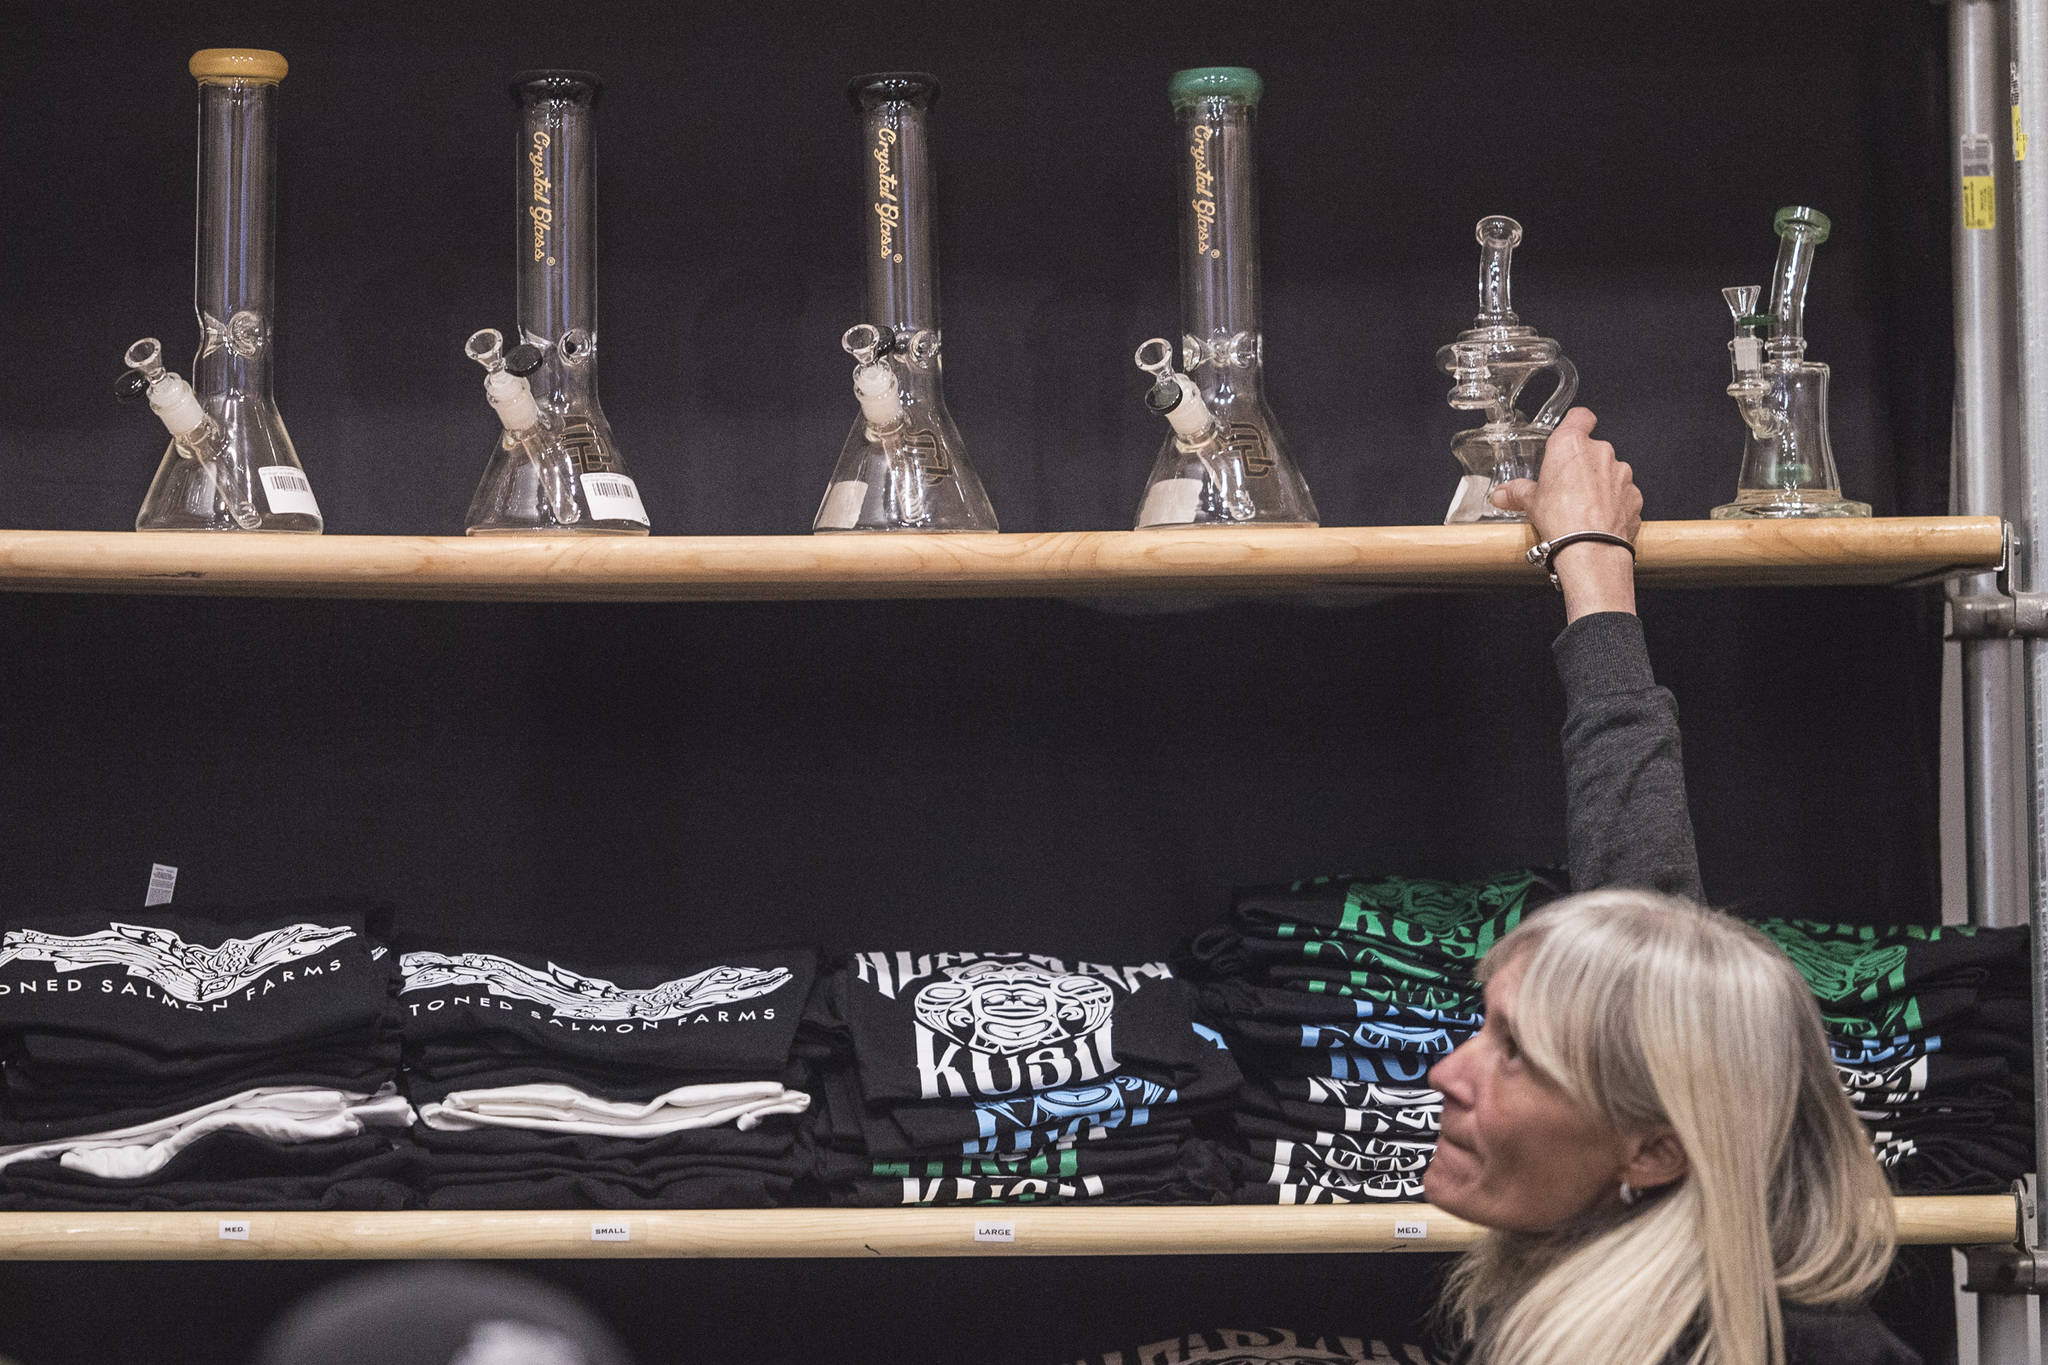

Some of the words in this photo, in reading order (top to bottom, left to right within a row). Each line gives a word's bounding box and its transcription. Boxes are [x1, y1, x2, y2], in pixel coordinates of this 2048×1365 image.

[529, 131, 551, 204] Crystal
[874, 128, 898, 201] Crystal
[1190, 125, 1214, 198] Crystal
[101, 979, 228, 1012] SALMON
[246, 960, 341, 1001] FARMS
[409, 995, 513, 1016] TONED
[531, 1010, 658, 1034] SALMON
[677, 1008, 775, 1027] FARMS
[978, 1228, 1011, 1236] LARGE
[1397, 1226, 1421, 1234] MED.
